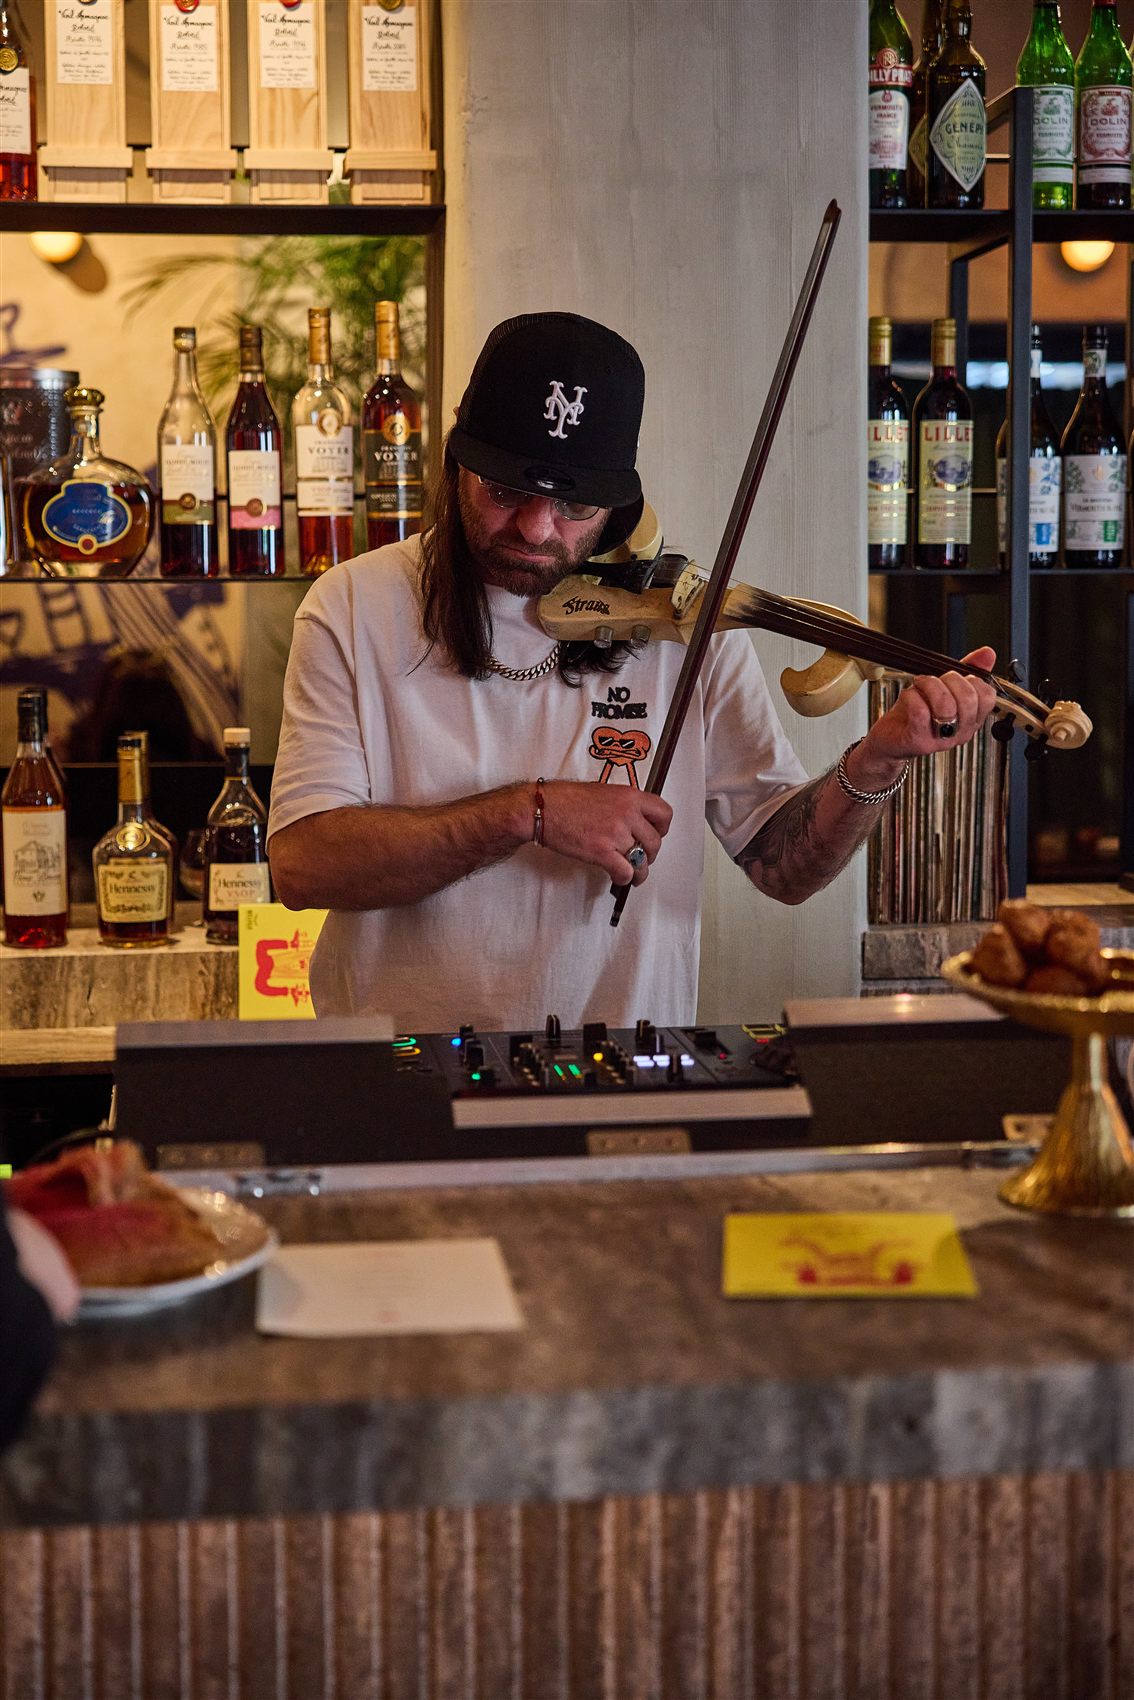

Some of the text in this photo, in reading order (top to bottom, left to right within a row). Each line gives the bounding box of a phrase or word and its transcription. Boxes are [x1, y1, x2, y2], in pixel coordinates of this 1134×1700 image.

[870, 68, 892, 82] ILLY
[1090, 117, 1127, 126] DOLIN
[308, 447, 350, 455] VOYER
[374, 451, 418, 462] VOYER
[607, 686, 631, 703] NO
[109, 882, 155, 895] Hennessy
[218, 878, 263, 890] Hennessy
